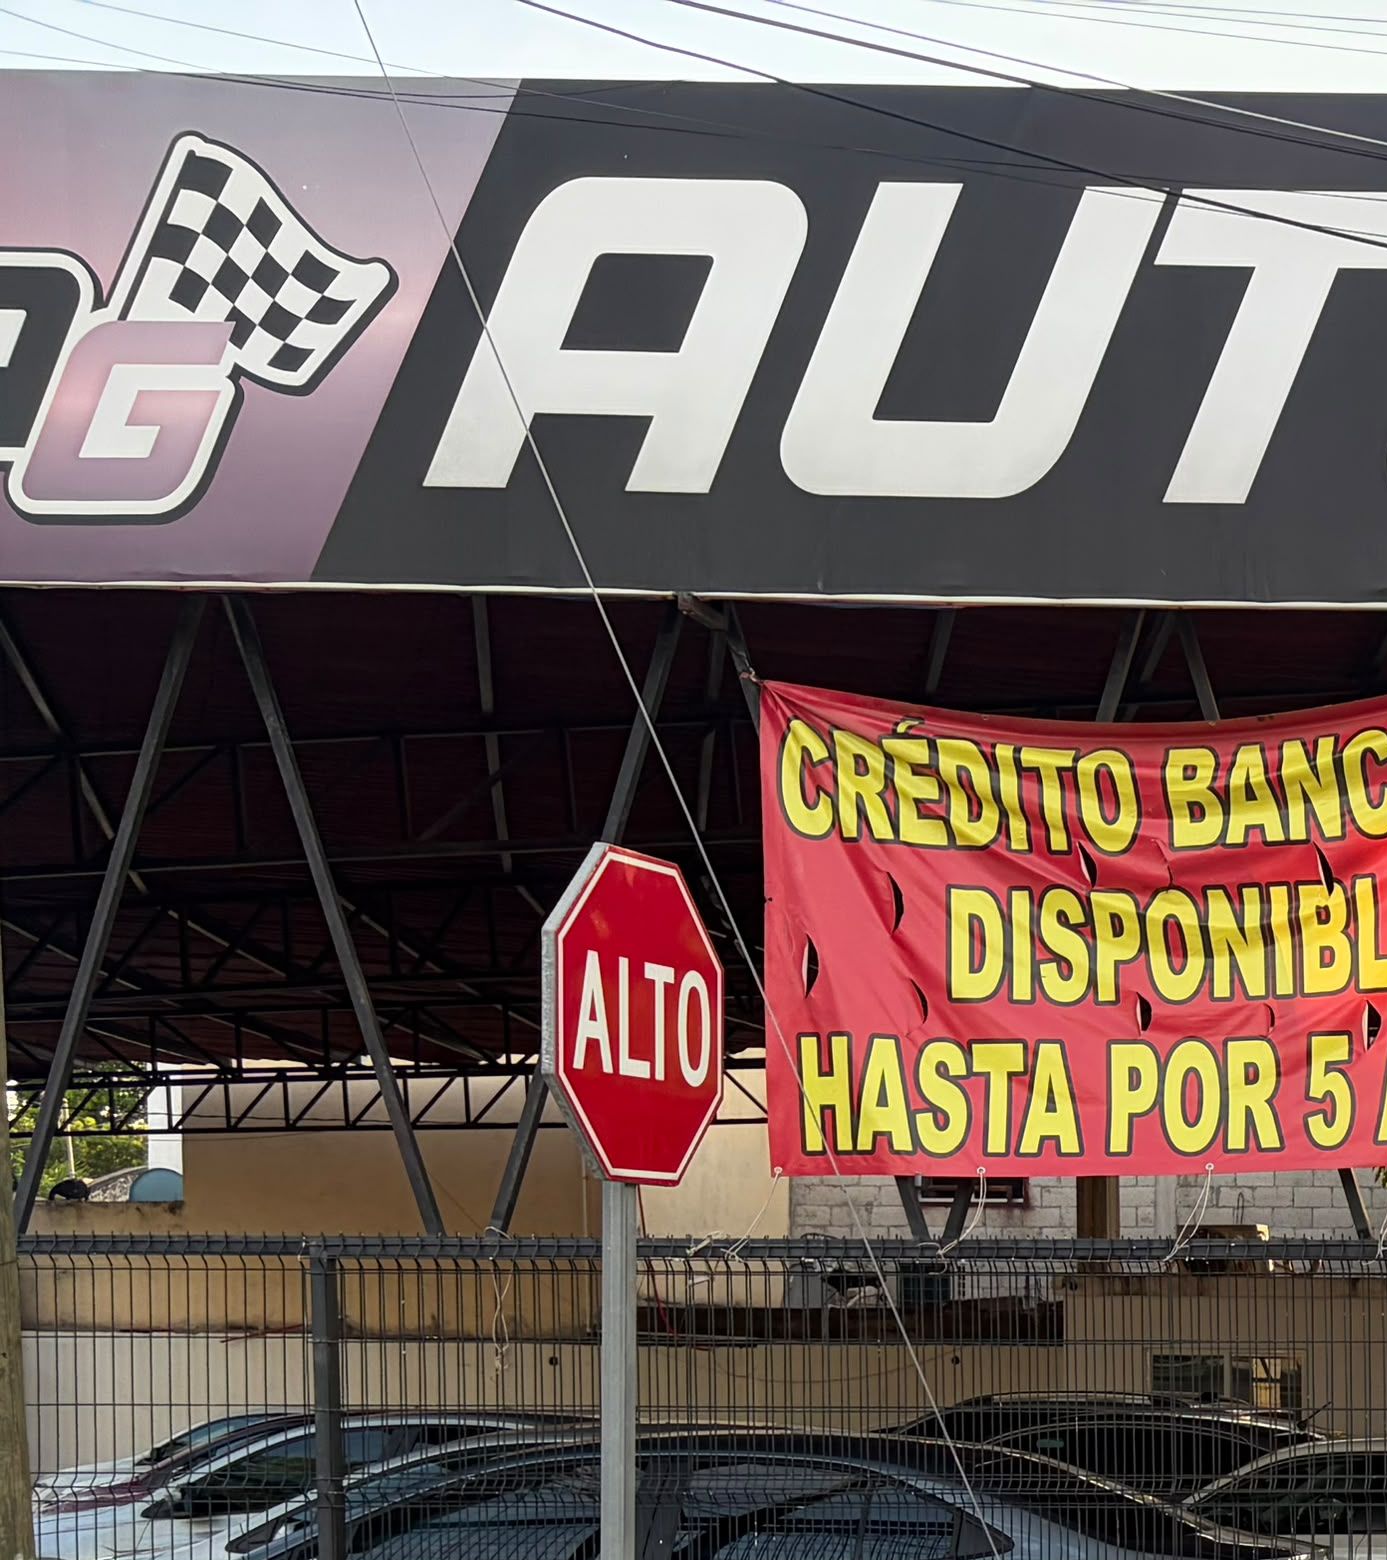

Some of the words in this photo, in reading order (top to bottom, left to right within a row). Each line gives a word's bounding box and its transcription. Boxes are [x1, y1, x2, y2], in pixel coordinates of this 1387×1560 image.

[780, 718, 1141, 855] CRÉDITO
[573, 950, 711, 1088] ALTO
[800, 1035, 1082, 1157] HASTA
[1109, 1039, 1281, 1155] POR
[1308, 1034, 1355, 1149] 5
